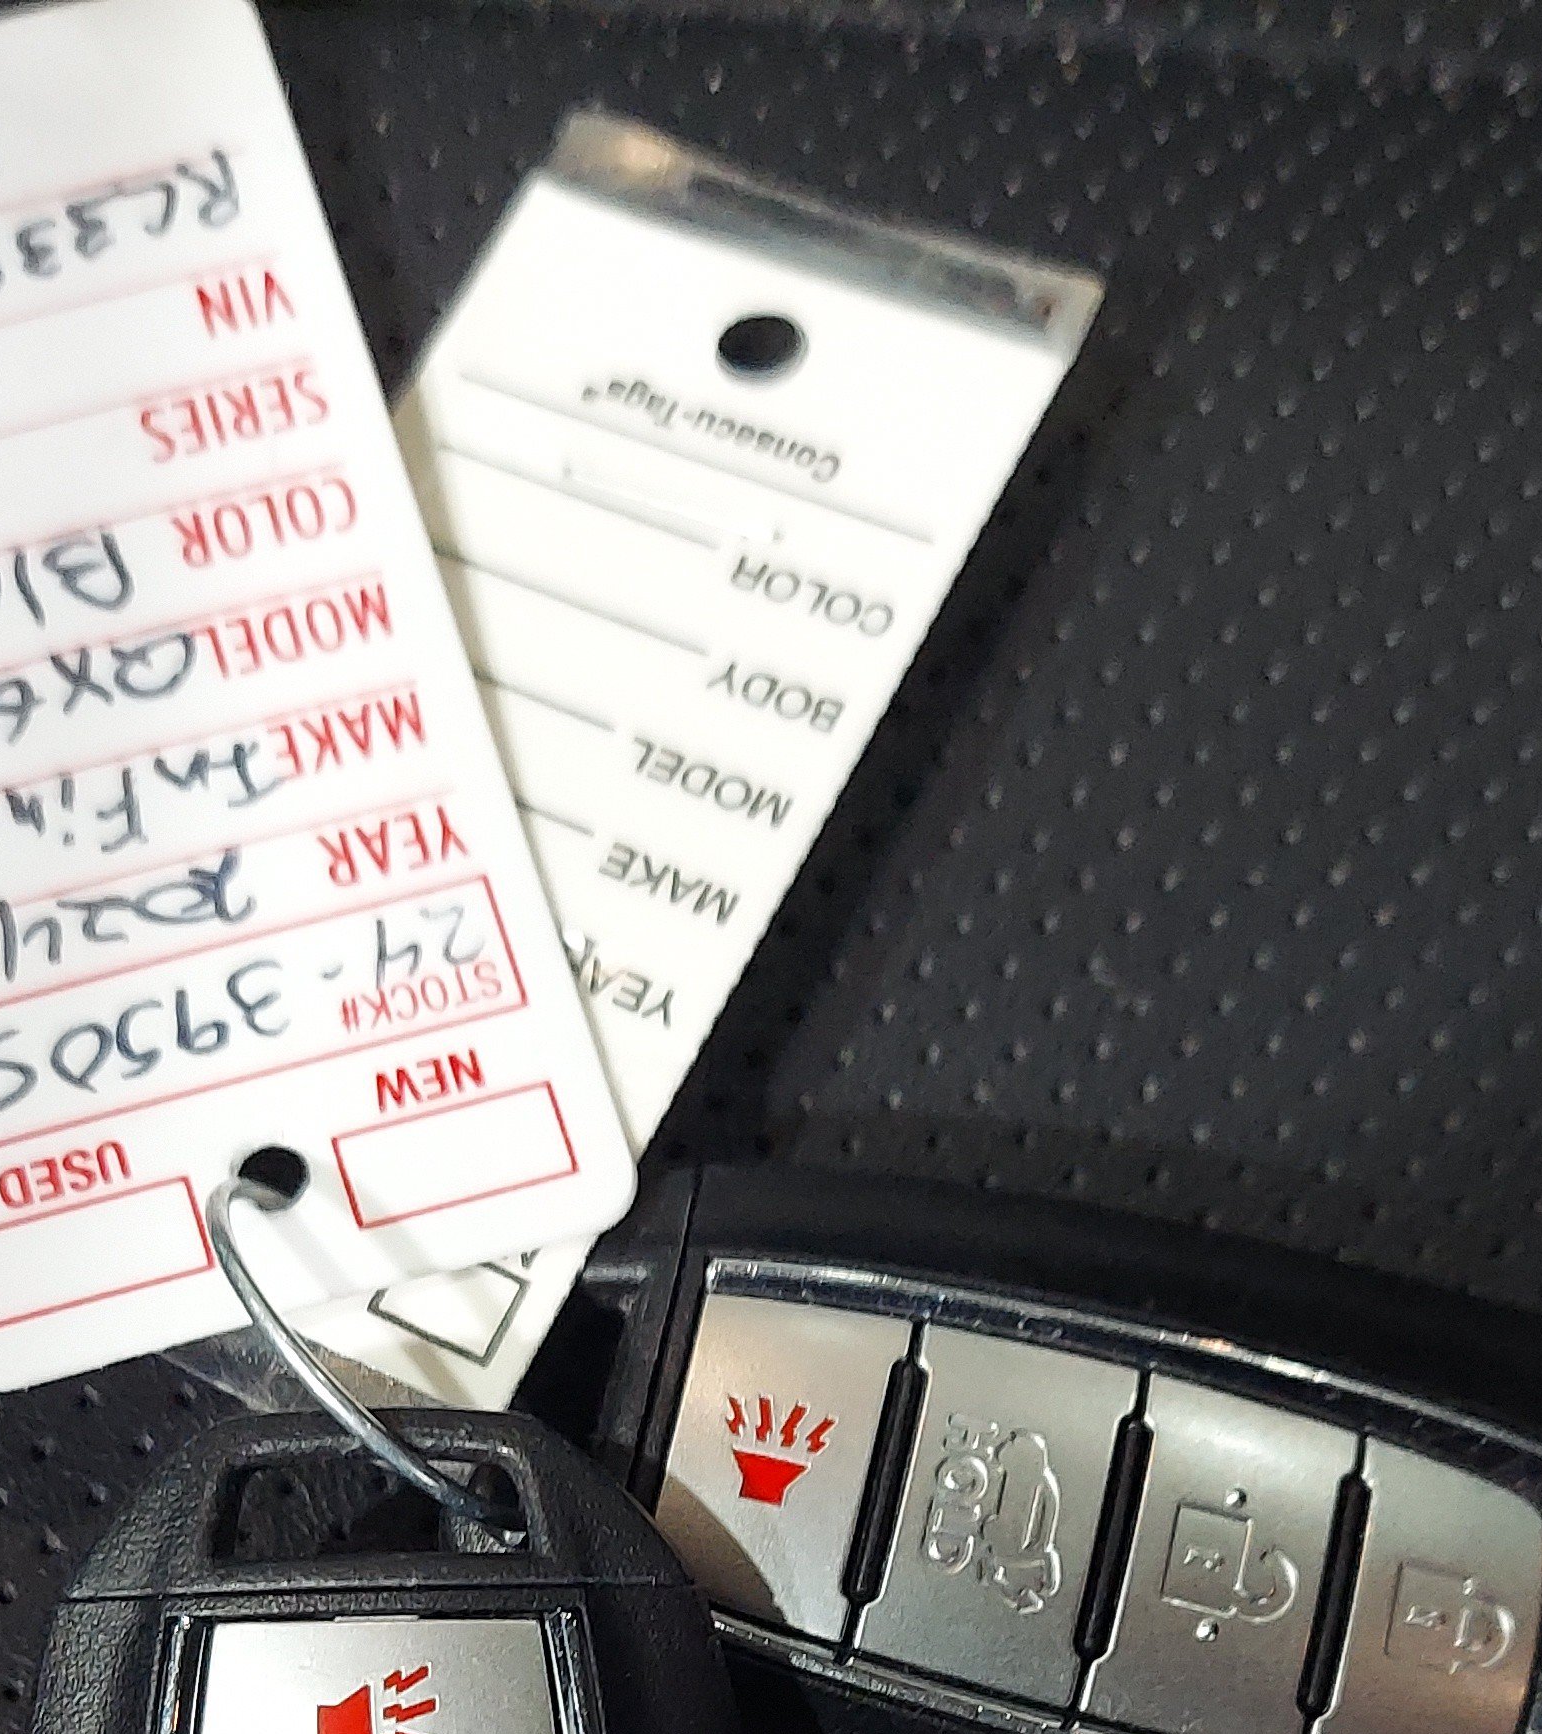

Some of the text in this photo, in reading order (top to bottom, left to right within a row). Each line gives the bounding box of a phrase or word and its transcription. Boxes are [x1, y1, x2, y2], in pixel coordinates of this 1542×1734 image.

[196, 271, 296, 340] VIN
[138, 370, 328, 465] SERIES
[170, 476, 358, 570] COLOR
[197, 582, 394, 681] MODEL
[730, 555, 895, 638] COLOR
[267, 690, 428, 778] MAKE
[706, 661, 845, 734] BODY
[633, 736, 792, 829] MODEL
[316, 804, 468, 887] YEAR
[598, 843, 740, 928] MAKE
[341, 961, 502, 1032] STOCK#
[374, 1048, 486, 1113] NEW
[920, 1413, 999, 1575] HOLD
